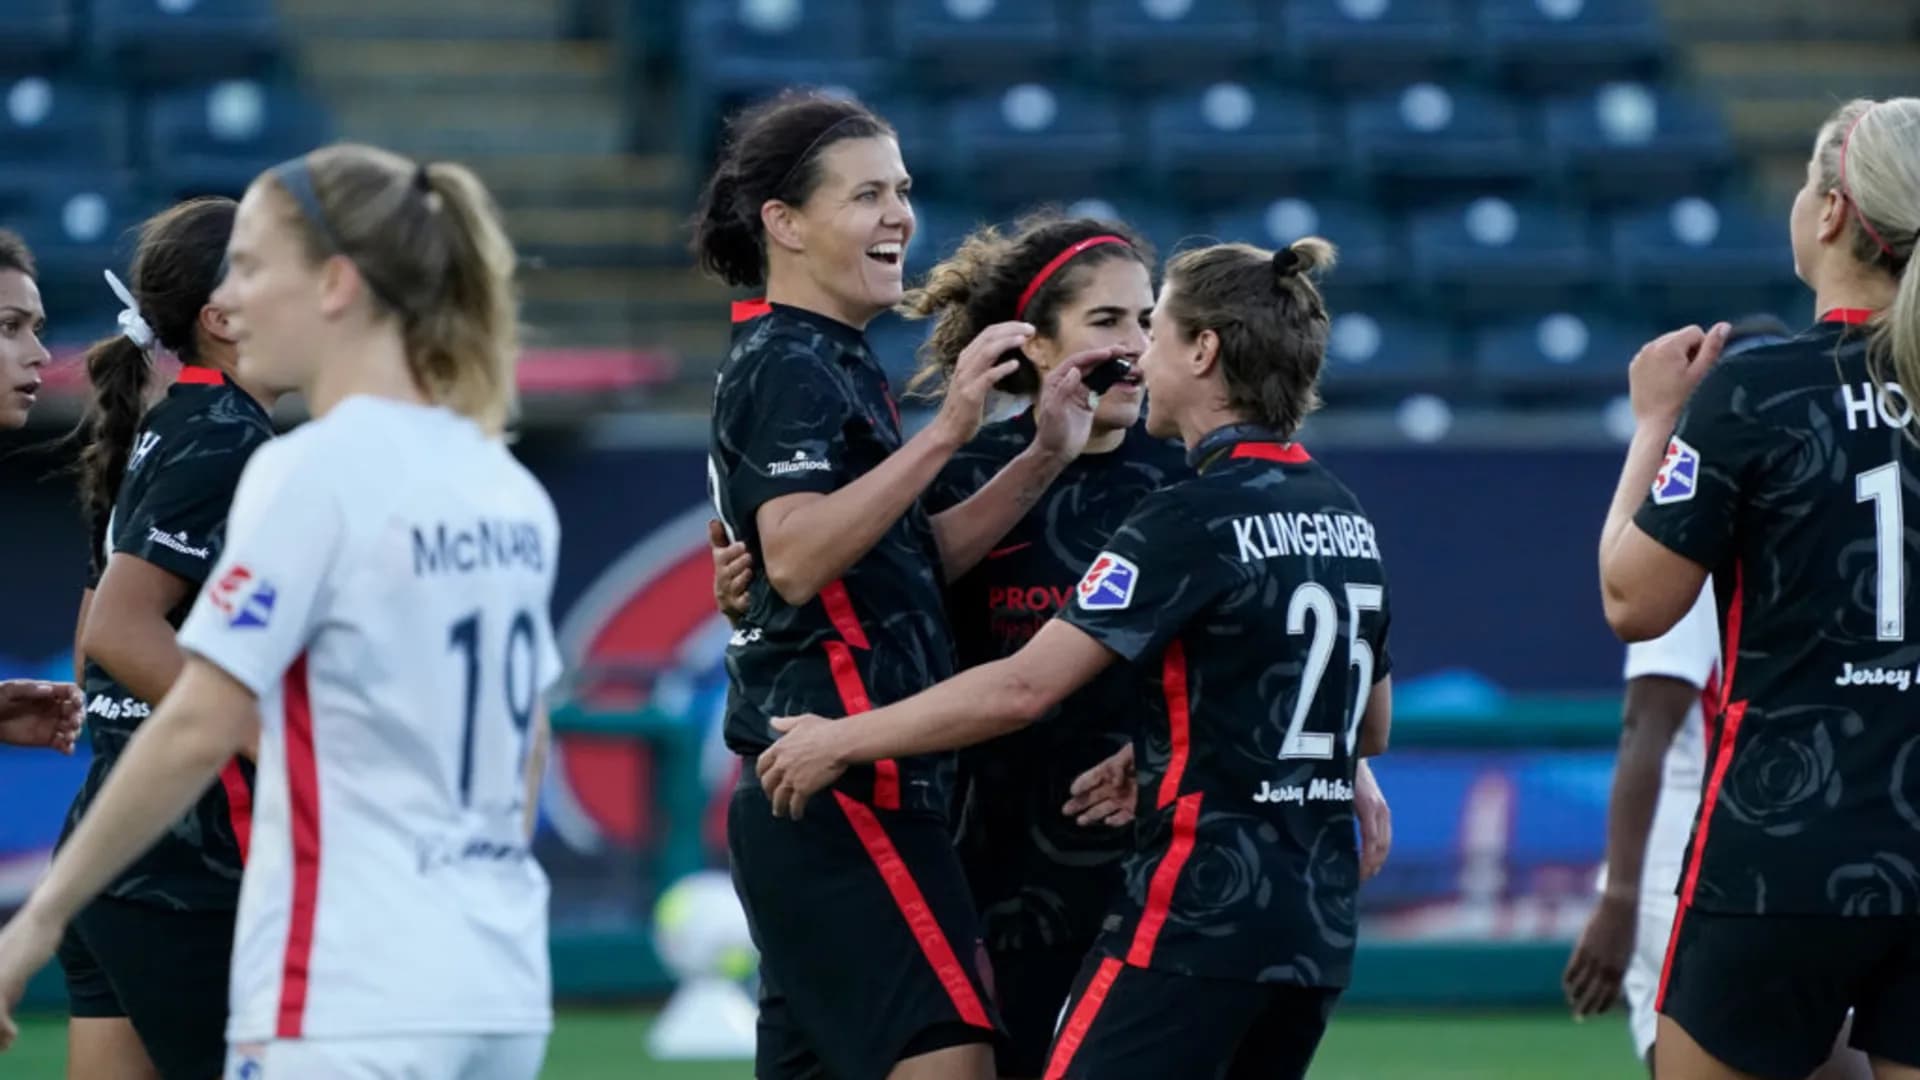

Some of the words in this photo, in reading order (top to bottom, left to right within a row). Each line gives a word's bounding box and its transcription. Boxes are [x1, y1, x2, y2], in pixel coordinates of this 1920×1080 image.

[767, 458, 832, 476] Tillamook
[148, 526, 210, 559] Tillamook
[1277, 581, 1384, 761] 25
[1834, 661, 1911, 692] Jersey
